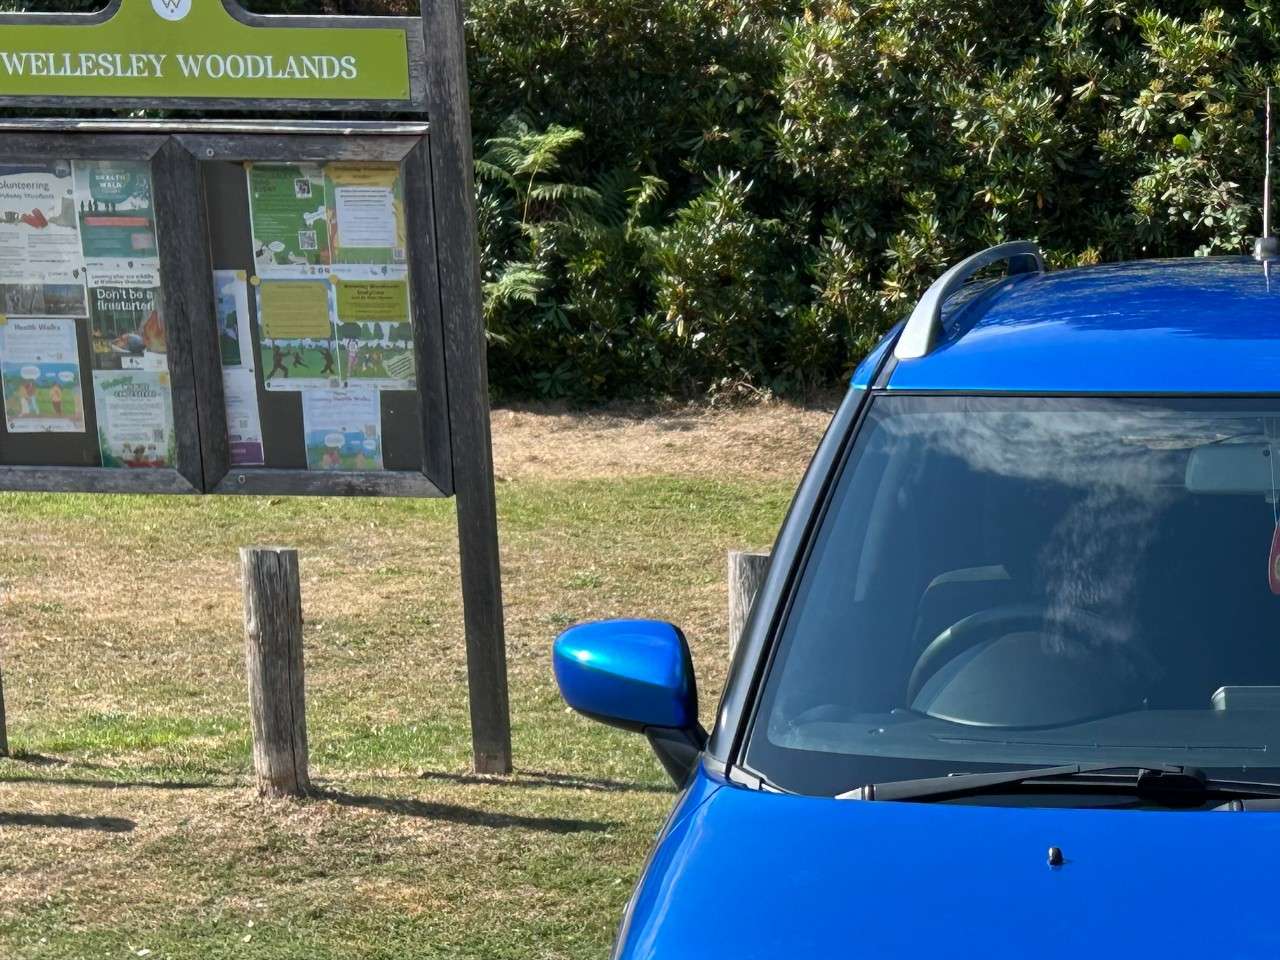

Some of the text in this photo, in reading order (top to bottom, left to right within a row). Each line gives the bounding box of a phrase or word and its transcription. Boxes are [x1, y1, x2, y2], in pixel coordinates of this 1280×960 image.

[1, 52, 358, 80] WELLESLEY WOODLANDS
[0, 180, 50, 192] olunteering
